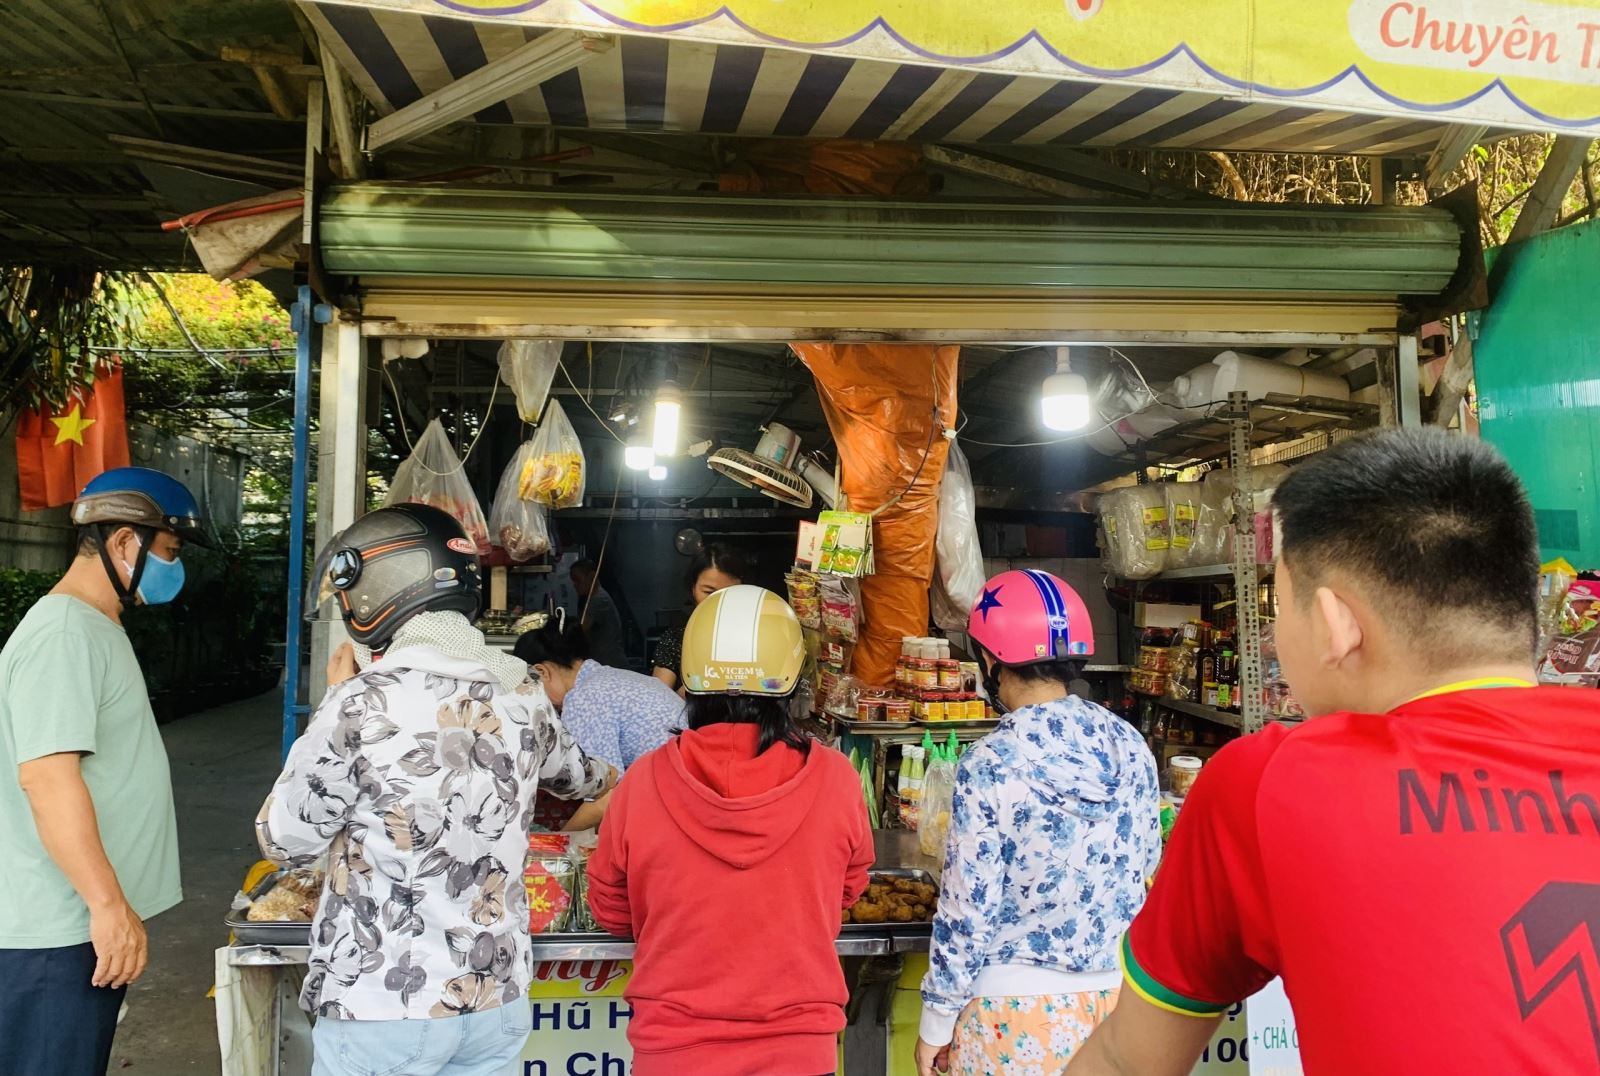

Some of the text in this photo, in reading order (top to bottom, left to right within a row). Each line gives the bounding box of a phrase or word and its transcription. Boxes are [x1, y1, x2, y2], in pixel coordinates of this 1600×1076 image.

[1380, 2, 1560, 67] Chuyên
[1398, 768, 1600, 835] Minh
[1263, 1019, 1288, 1050] CHẢ
